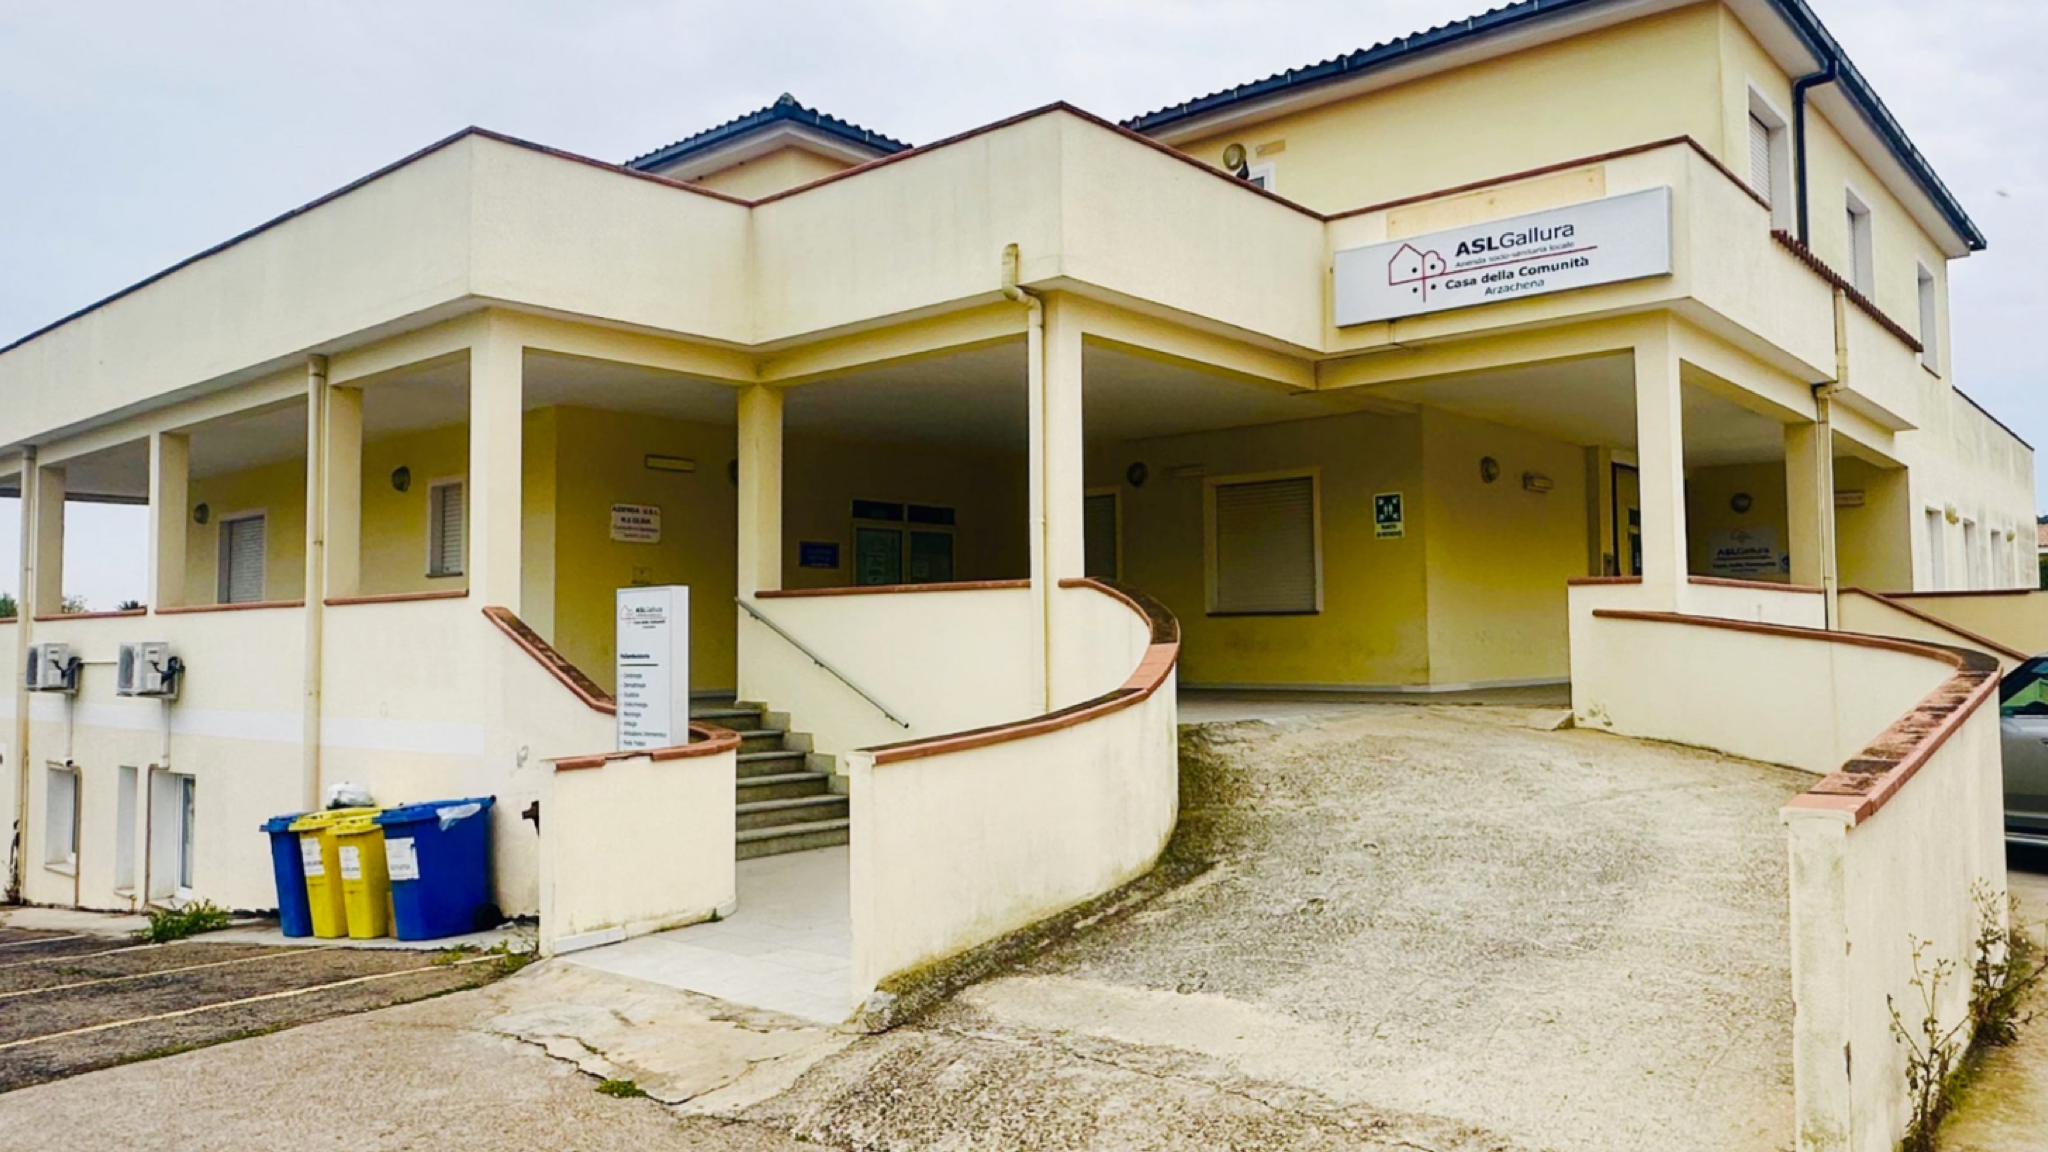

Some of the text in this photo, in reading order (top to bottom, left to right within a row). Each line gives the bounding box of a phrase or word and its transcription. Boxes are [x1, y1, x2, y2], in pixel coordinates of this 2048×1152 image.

[1445, 256, 1590, 290] Casa della Comunità
[1484, 278, 1546, 296] Arzachena
